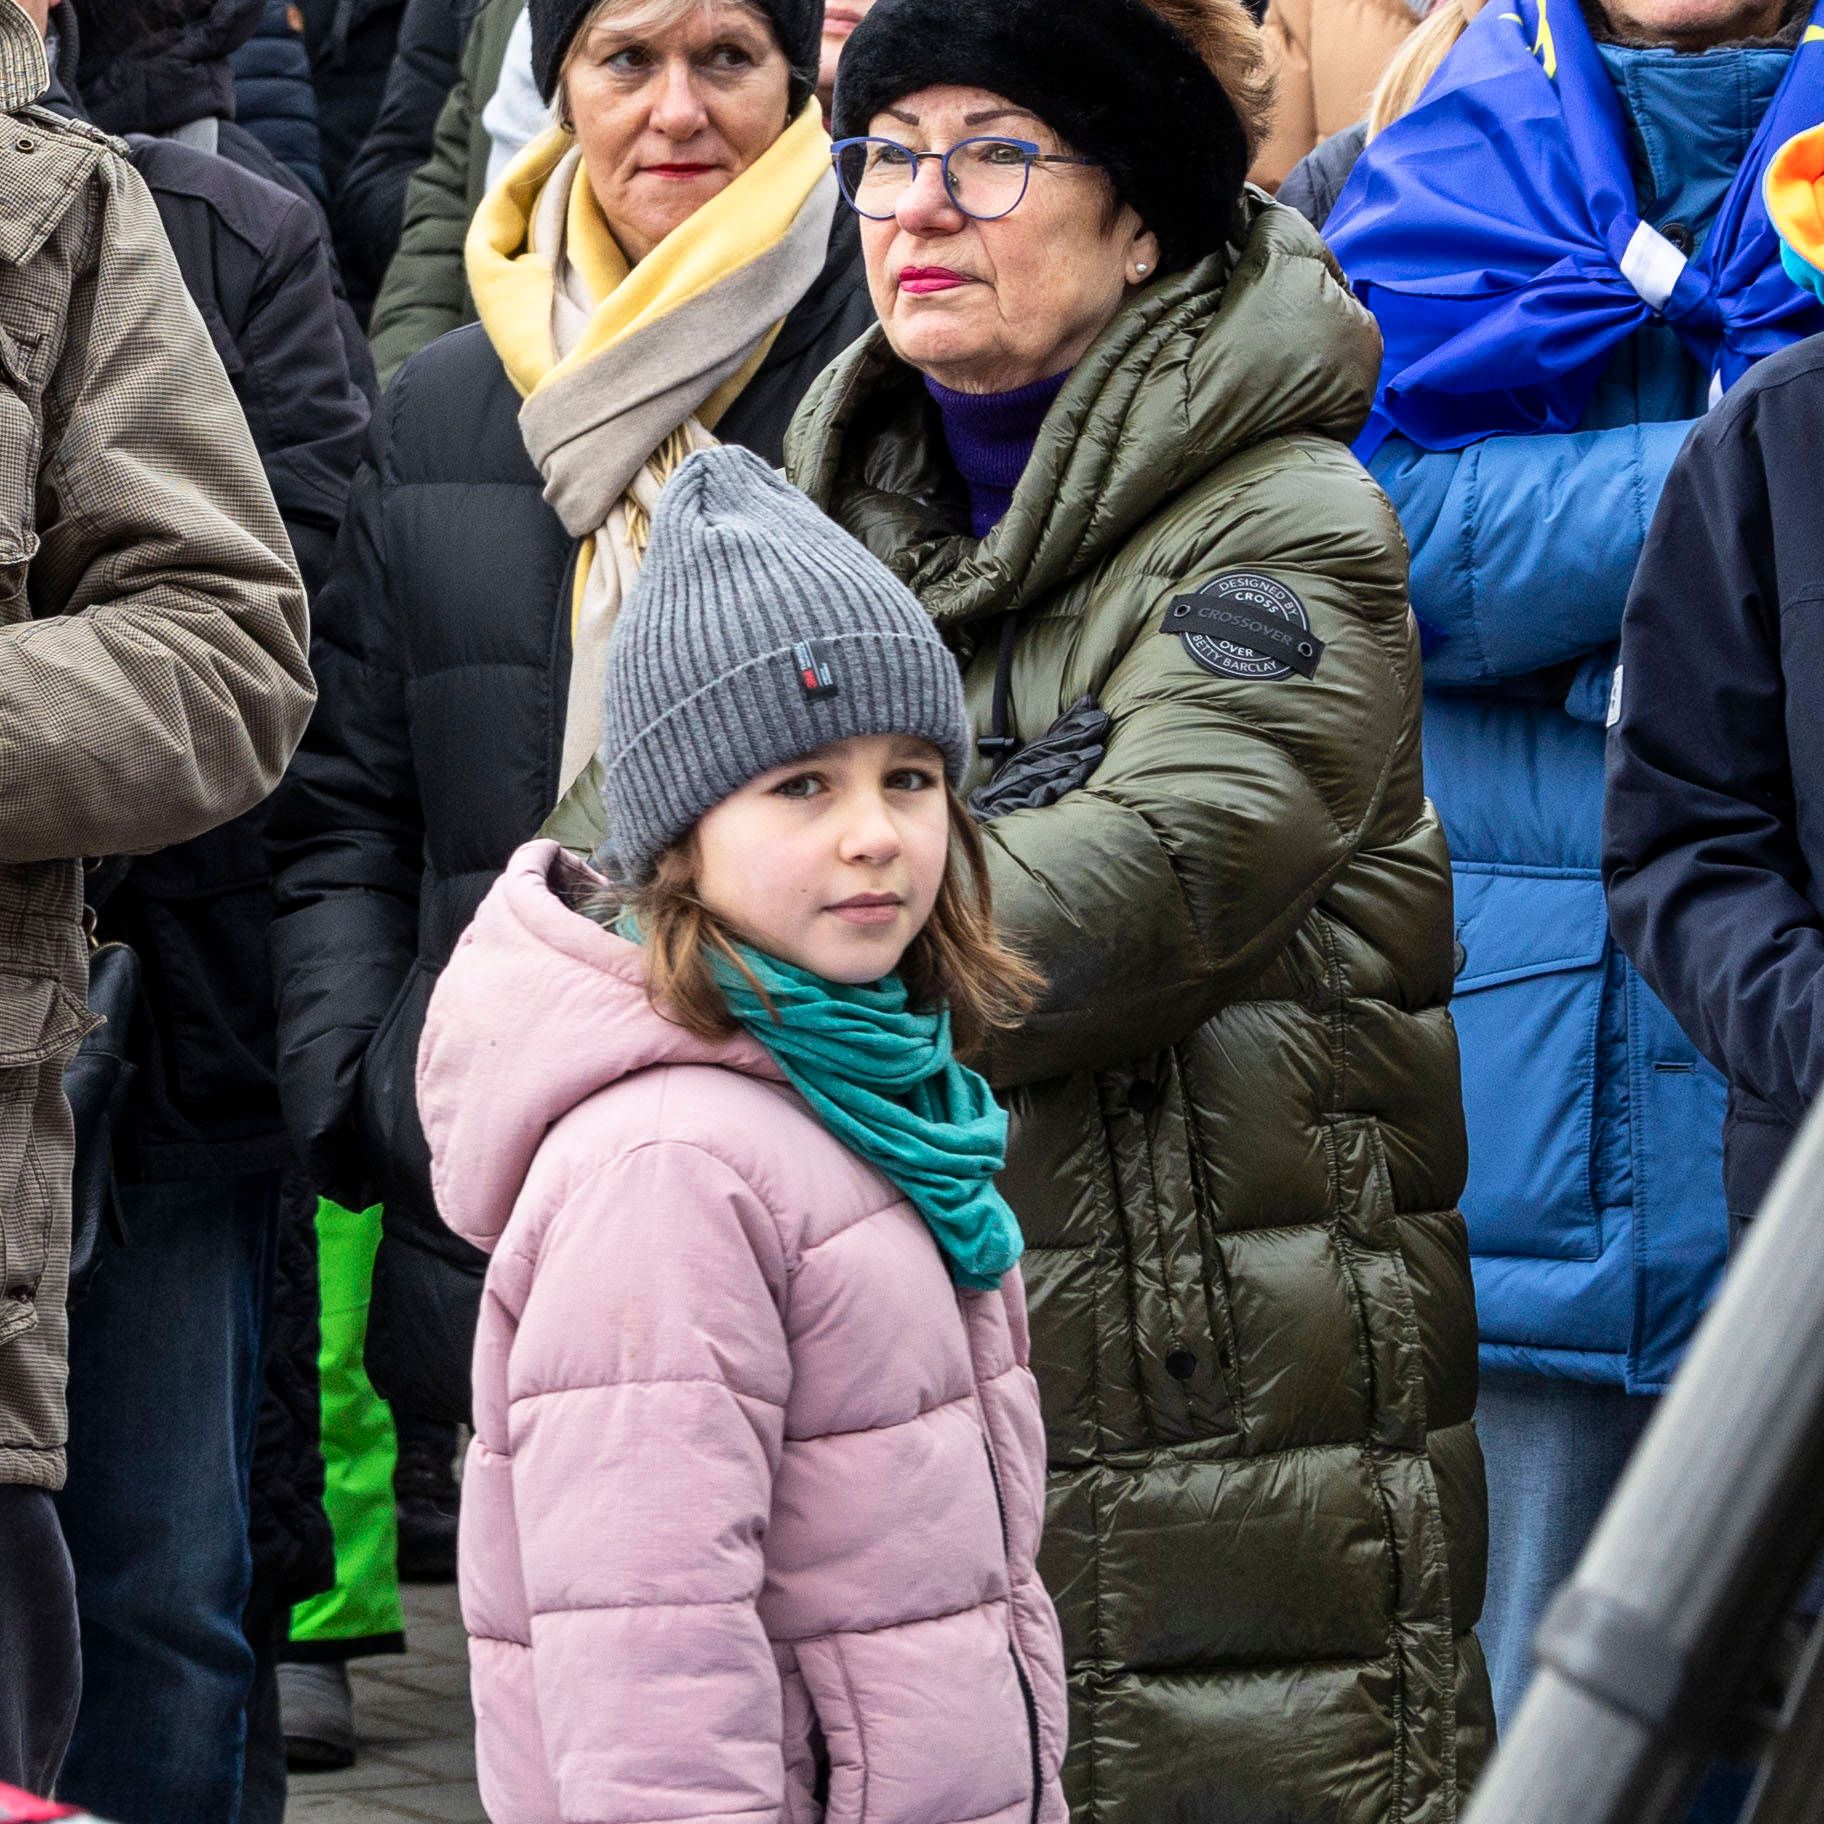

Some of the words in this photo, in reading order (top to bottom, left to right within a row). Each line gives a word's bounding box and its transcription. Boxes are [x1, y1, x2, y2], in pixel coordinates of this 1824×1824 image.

[1219, 577, 1286, 601] DESIGNED
[1283, 601, 1300, 617] BY
[1235, 591, 1279, 614] CROSS
[1197, 606, 1294, 647] CROSSOVER
[1192, 634, 1223, 663] BETTY
[1221, 657, 1278, 673] BARCLAY
[1219, 639, 1254, 658] OVER
